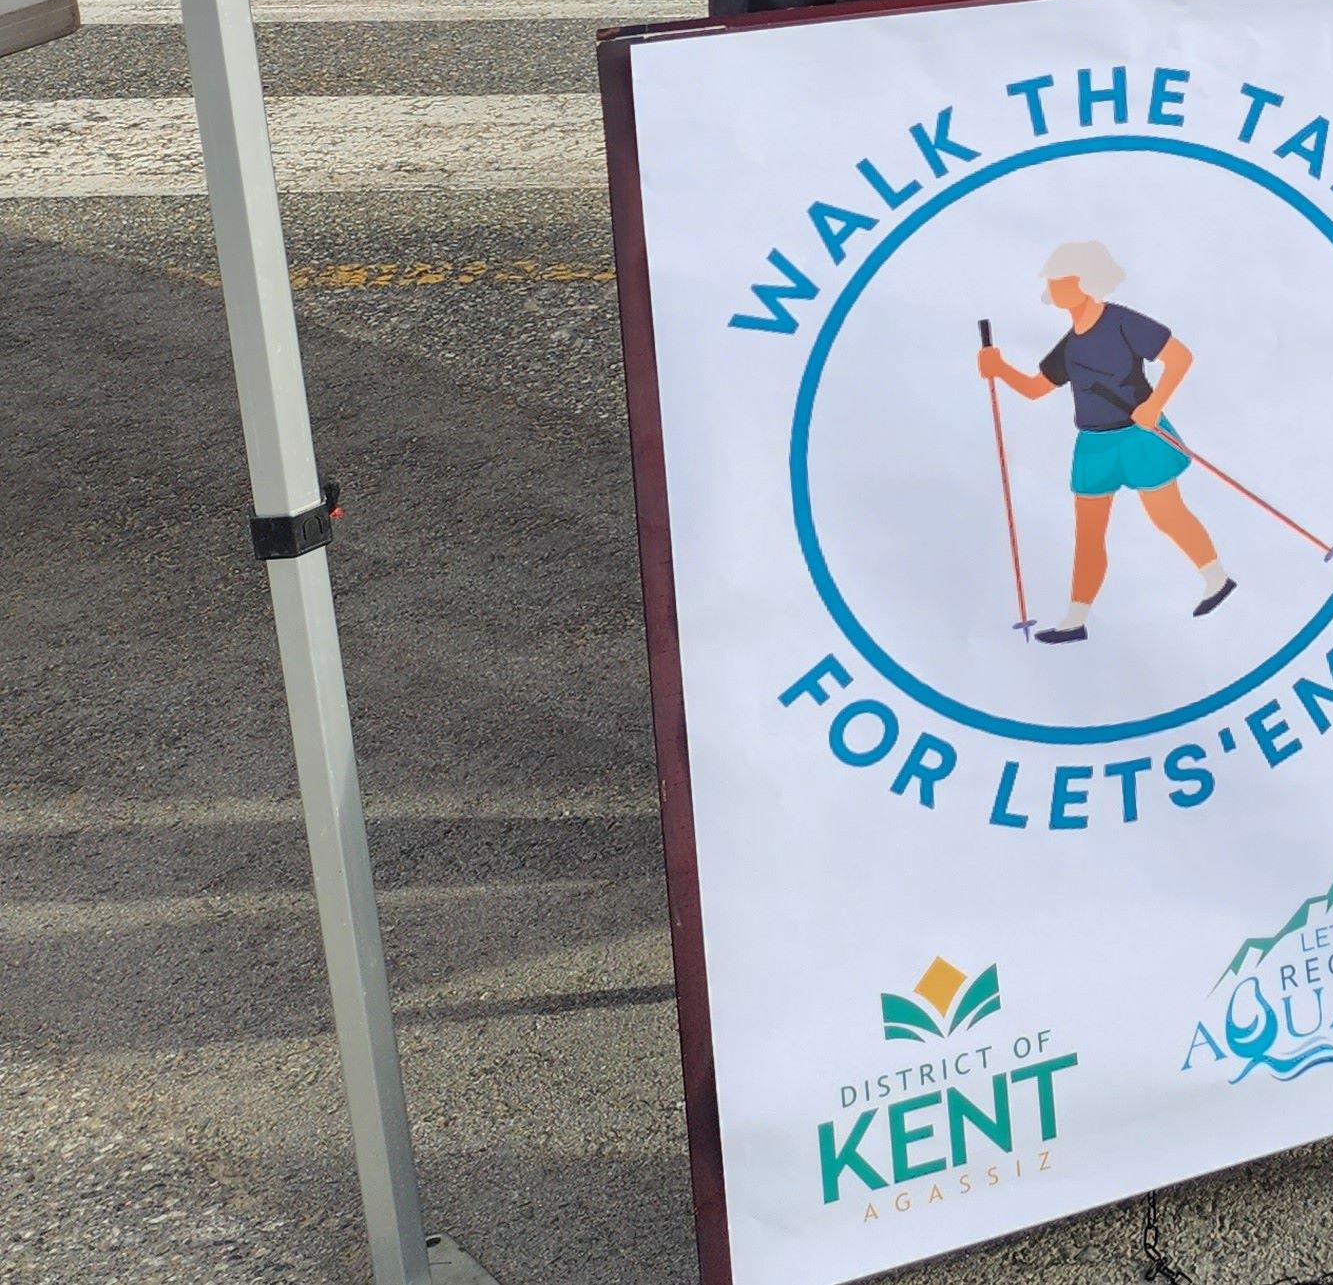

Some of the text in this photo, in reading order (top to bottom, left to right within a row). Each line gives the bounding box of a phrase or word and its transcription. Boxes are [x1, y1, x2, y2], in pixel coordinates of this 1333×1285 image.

[728, 106, 981, 336] WALK
[1006, 66, 1190, 137] THE
[777, 654, 957, 809] FOR
[817, 1052, 1078, 1204] KENT
[841, 1029, 1051, 1108] DISTRICT OF
[864, 1151, 1051, 1222] AGASSIZ
